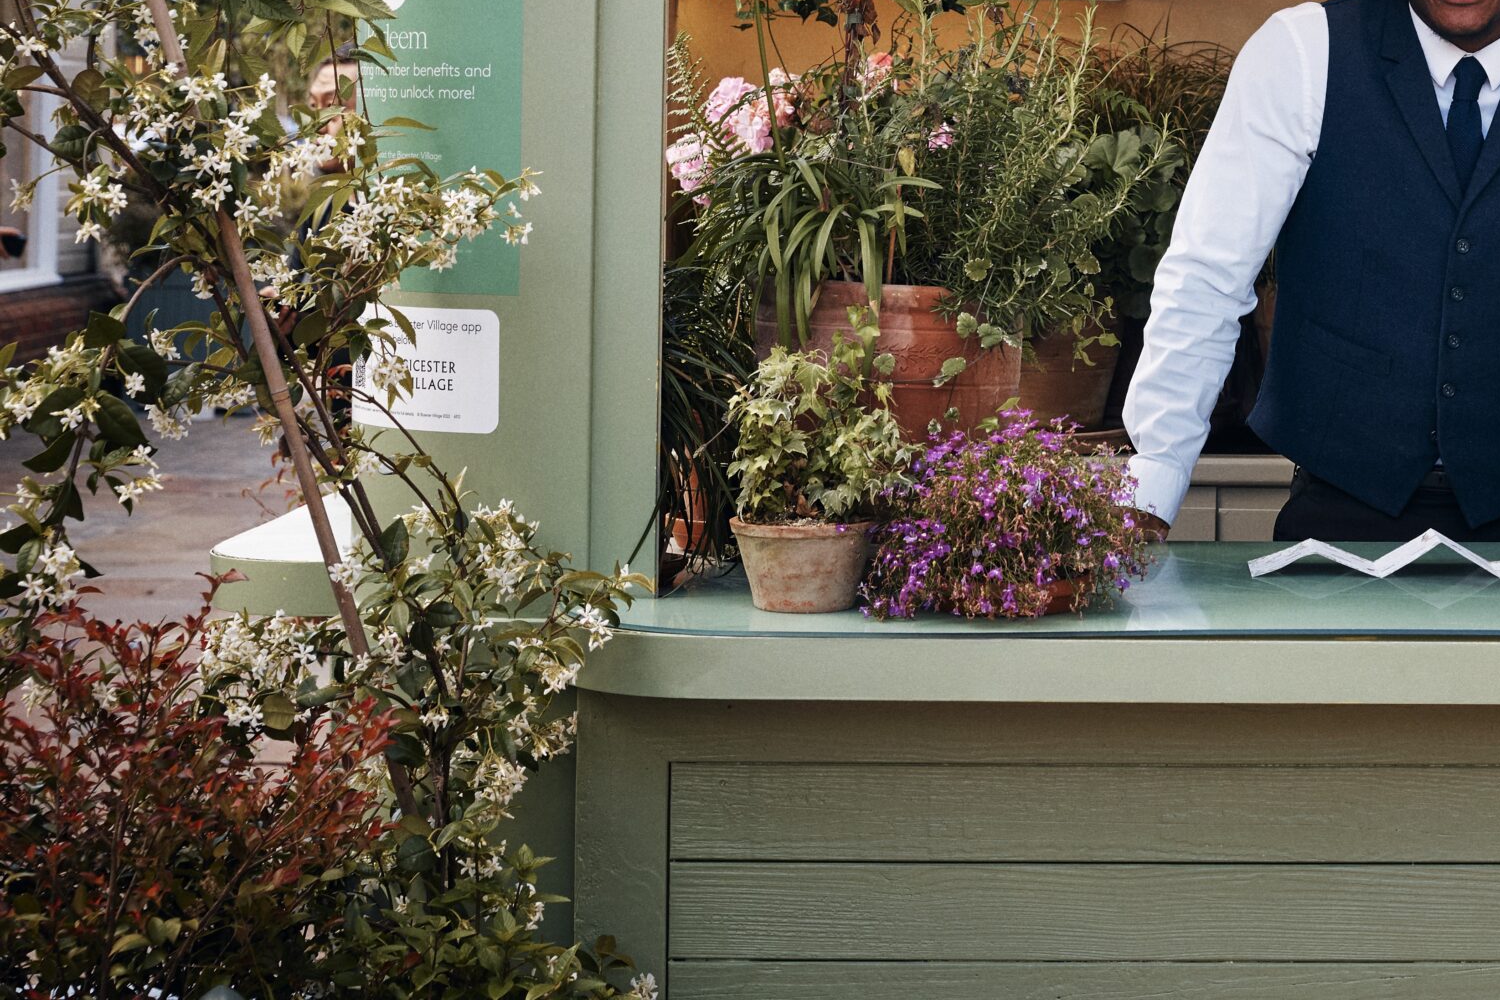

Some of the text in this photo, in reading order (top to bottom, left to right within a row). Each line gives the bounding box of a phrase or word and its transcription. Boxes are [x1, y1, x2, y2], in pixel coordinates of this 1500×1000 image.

[413, 62, 461, 77] benefits
[464, 64, 492, 77] and
[388, 86, 398, 99] to
[400, 84, 435, 99] unlock
[438, 85, 475, 100] more!
[427, 319, 458, 335] Village
[461, 322, 482, 335] app
[411, 377, 454, 391] ILLAGE
